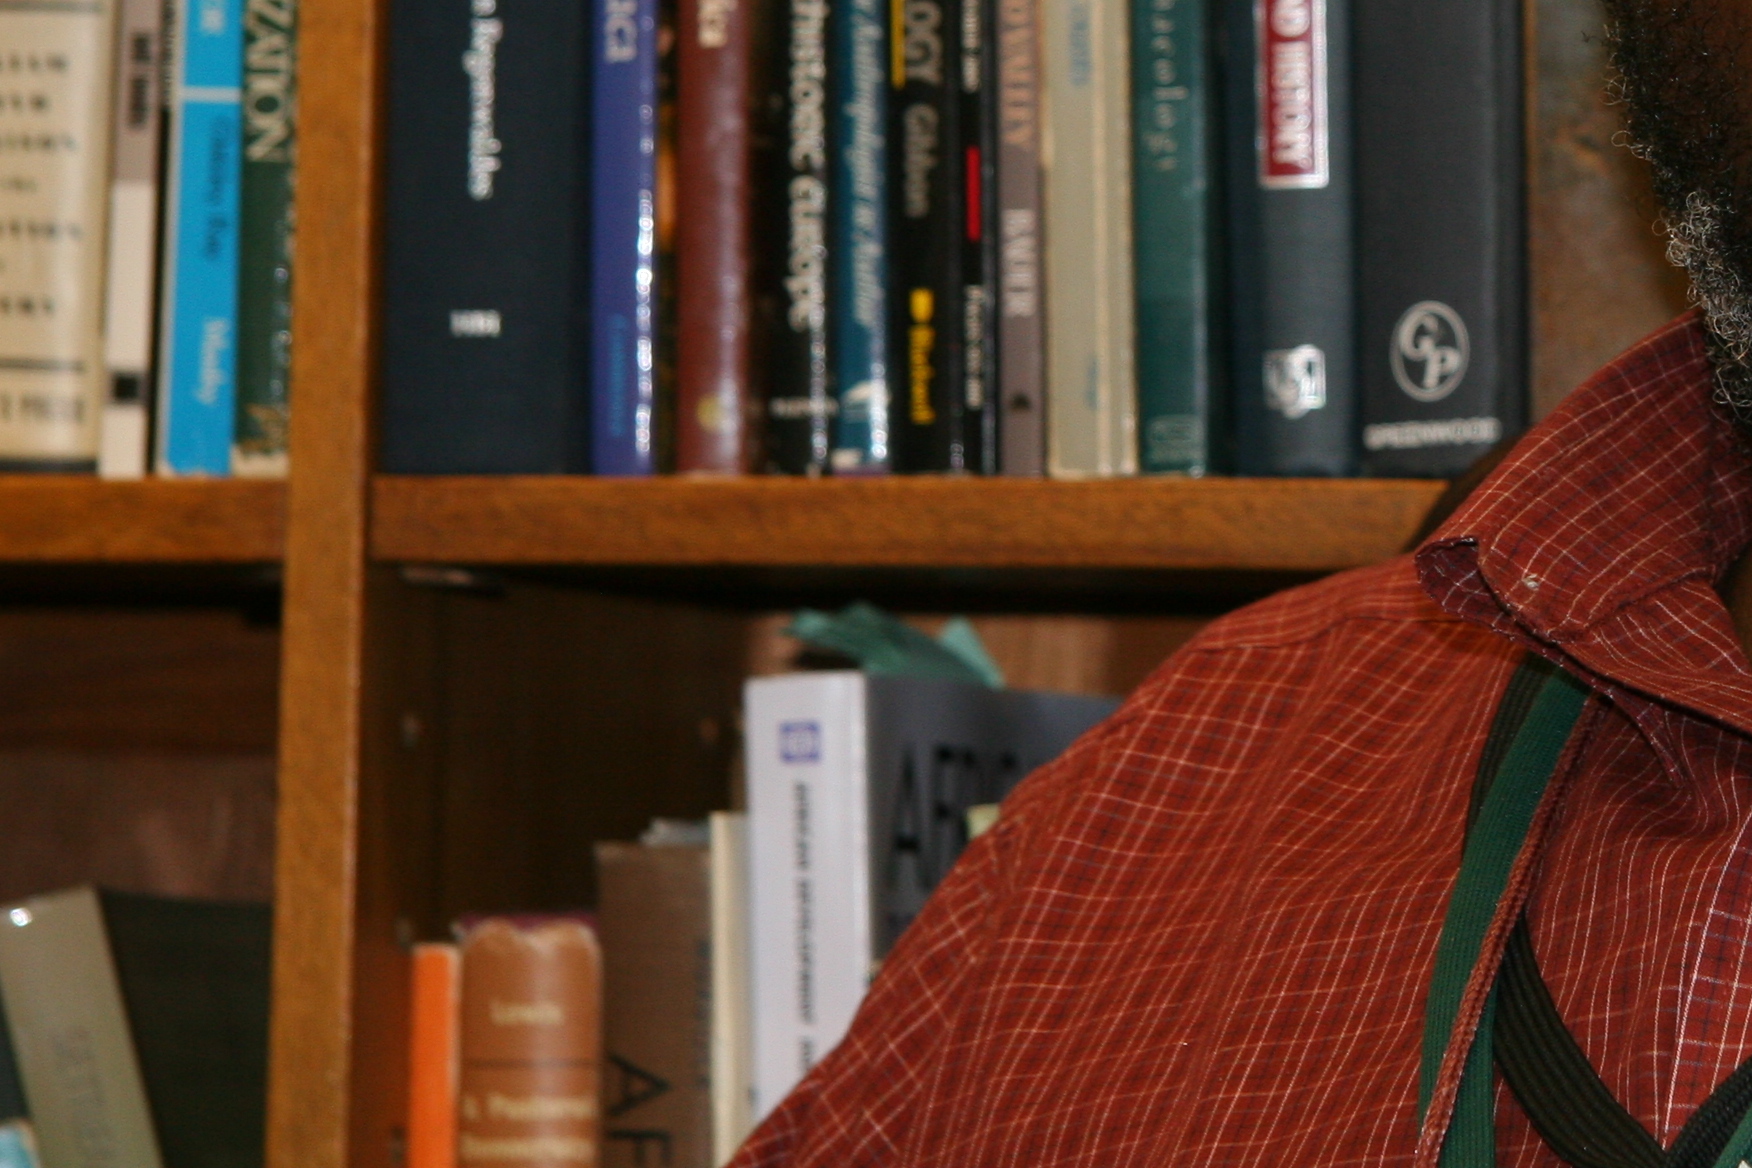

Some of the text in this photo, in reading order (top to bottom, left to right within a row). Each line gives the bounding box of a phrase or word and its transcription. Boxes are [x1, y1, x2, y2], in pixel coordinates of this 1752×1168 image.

[842, 15, 886, 200] Anthropologist
[1003, 24, 1036, 152] VALLEY
[1272, 41, 1312, 171] HISTORY
[903, 103, 941, 219] Gibbon
[853, 236, 884, 330] Author
[1003, 207, 1037, 319] BAUER
